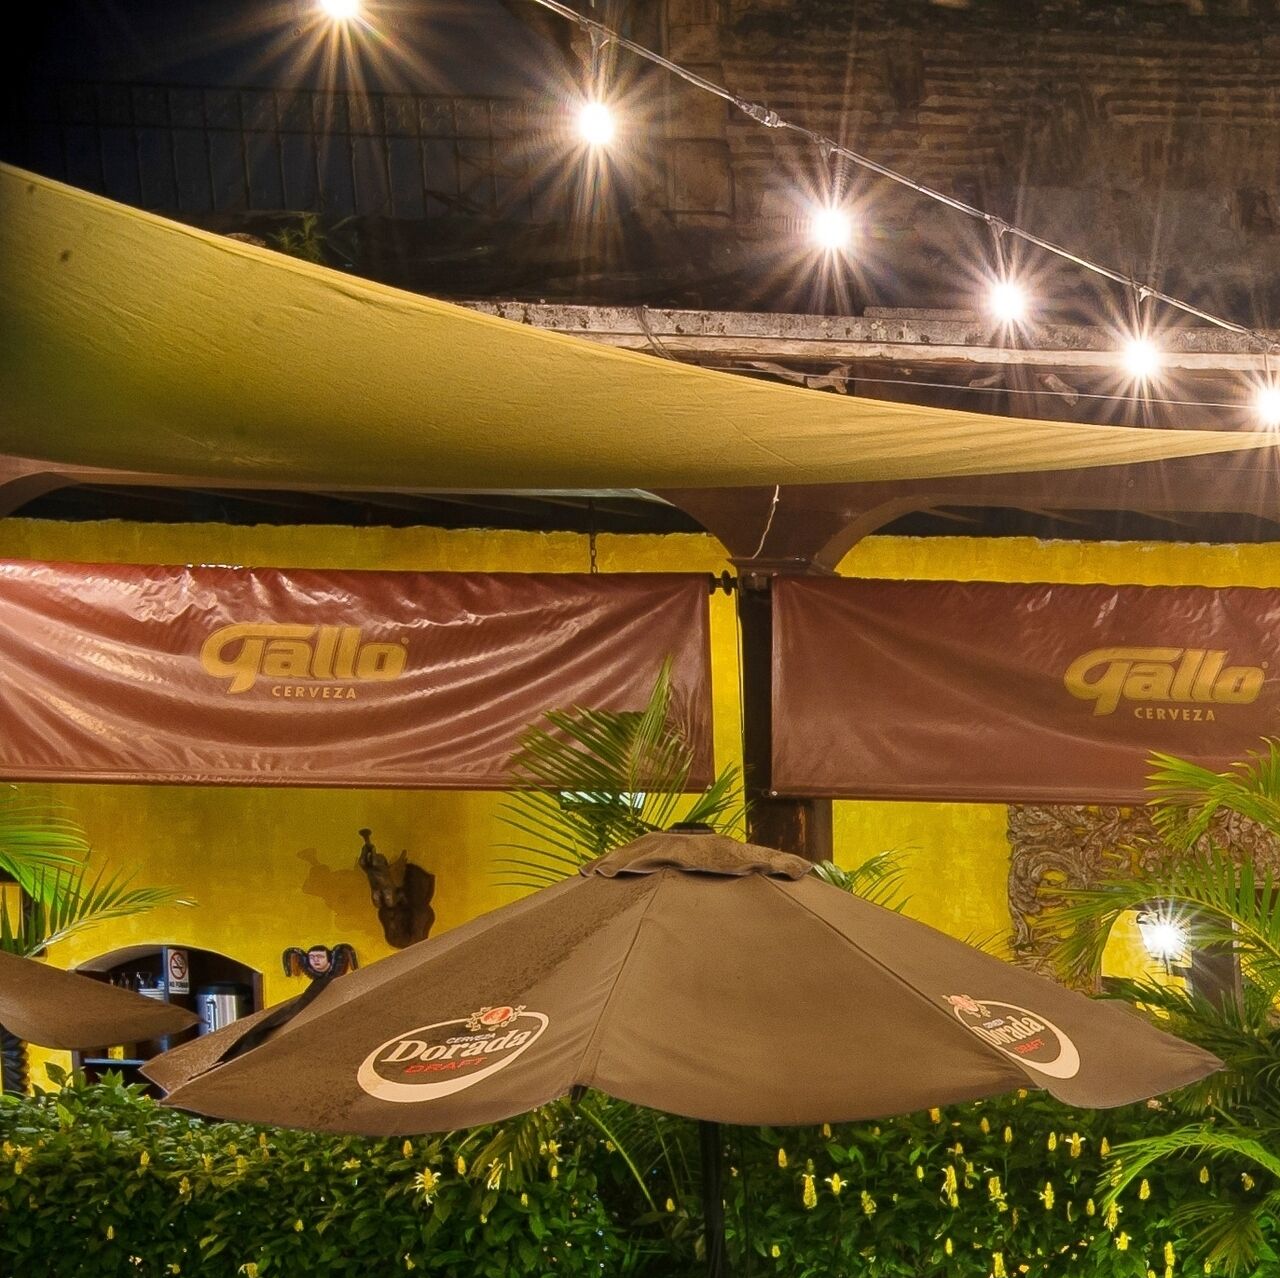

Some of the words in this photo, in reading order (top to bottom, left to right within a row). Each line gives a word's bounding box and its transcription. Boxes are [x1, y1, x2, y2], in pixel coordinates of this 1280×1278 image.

[201, 624, 407, 694] Gallo
[271, 685, 357, 699] CERVEZA
[1063, 646, 1266, 716] Gallo
[1134, 707, 1216, 721] CERVEZA
[381, 1029, 532, 1063] Dorada
[971, 1015, 1045, 1046] Dorada
[404, 1056, 488, 1075] DRAFT
